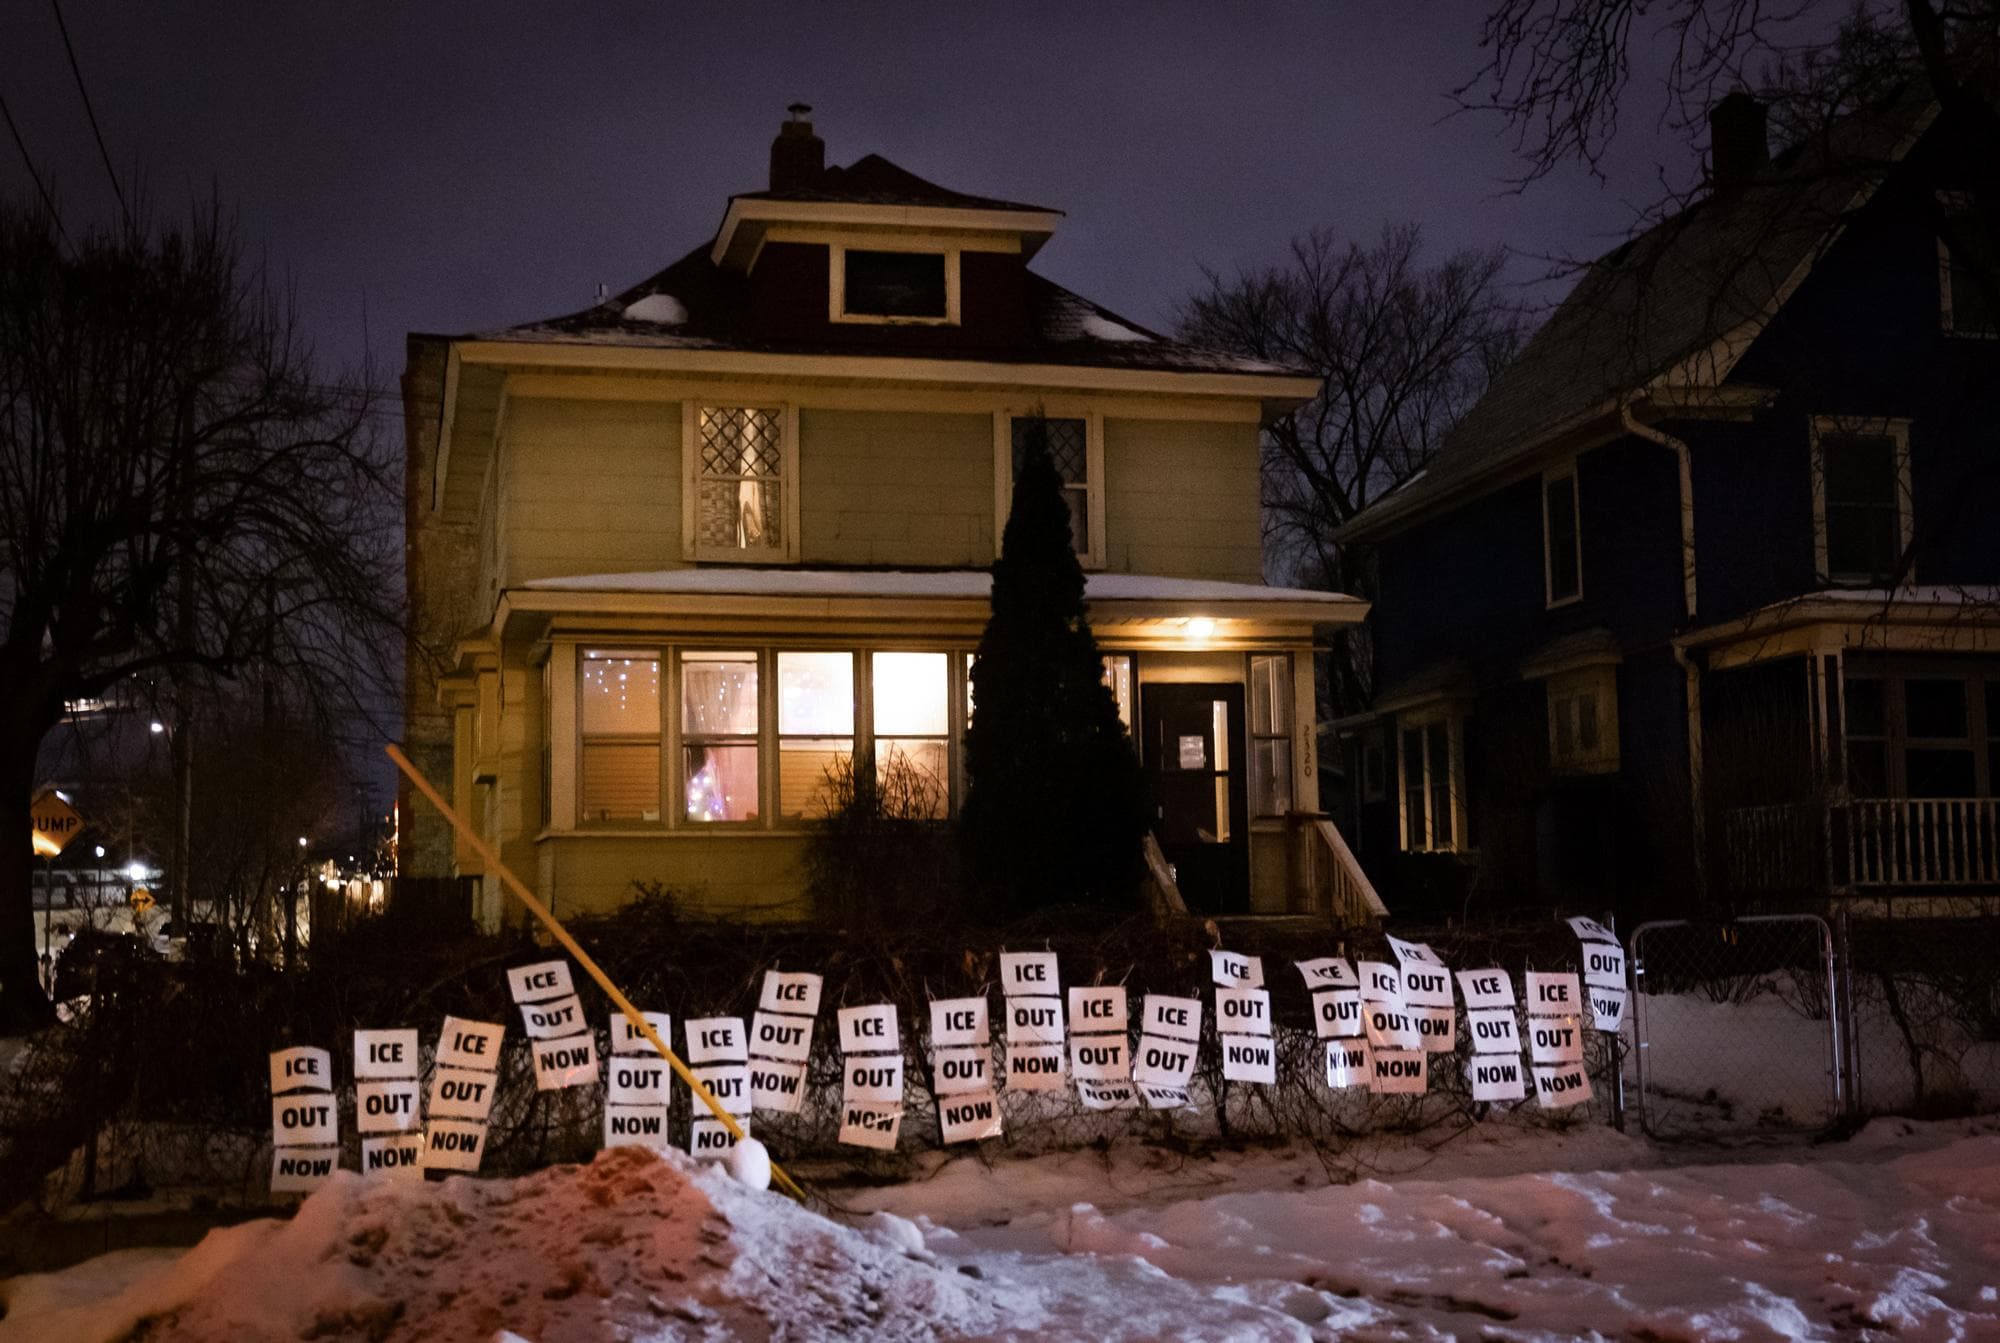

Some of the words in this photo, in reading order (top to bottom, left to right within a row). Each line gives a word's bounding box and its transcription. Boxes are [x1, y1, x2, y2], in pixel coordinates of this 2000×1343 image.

[1400, 947, 1427, 961] ICE
[1015, 964, 1046, 982] ICE
[1223, 959, 1250, 979] ICE
[1312, 966, 1342, 979] ICE
[1590, 954, 1621, 975] OUT
[525, 972, 557, 990] ICE
[1373, 973, 1396, 994] ICE
[1408, 974, 1445, 992] OUT
[1472, 977, 1501, 995] ICE
[776, 984, 808, 1001] ICE
[1539, 985, 1568, 1001] ICE
[531, 1006, 574, 1027] OUT
[1015, 1009, 1056, 1027] OUT
[1083, 999, 1113, 1018] ICE
[1158, 1007, 1188, 1026] ICE
[1224, 1000, 1263, 1018] OUT
[1323, 1002, 1359, 1021] OUT
[854, 1018, 884, 1037] ICE
[945, 1012, 975, 1030] ICE
[1373, 1013, 1409, 1031] OUT
[1477, 1021, 1510, 1038] OUT
[626, 1024, 657, 1040] IC
[702, 1030, 733, 1048] ICE
[760, 1024, 804, 1045] OUT
[1536, 1030, 1573, 1047] OUT
[370, 1043, 403, 1063] ICE
[454, 1033, 488, 1054] ICE
[540, 1048, 589, 1071] NOW
[1013, 1056, 1058, 1074] NOW
[1079, 1047, 1120, 1065] OUT
[1146, 1049, 1189, 1073] OUT
[1229, 1046, 1270, 1065] NOW
[286, 1057, 318, 1077] ICE
[943, 1059, 985, 1079] OUT
[1376, 1061, 1421, 1077] NOW
[1478, 1066, 1516, 1083] NOW
[618, 1070, 662, 1088] OUT
[751, 1071, 799, 1094] NOW
[853, 1069, 895, 1088] OUT
[1541, 1073, 1582, 1092] NOW
[441, 1081, 486, 1102] OUT
[1085, 1089, 1130, 1100] NOW
[1148, 1089, 1189, 1101] NOW
[366, 1094, 411, 1115] OUT
[947, 1102, 992, 1125] NOW
[282, 1107, 329, 1129] OUT
[612, 1117, 660, 1134] NOW
[848, 1110, 894, 1131] NOW
[431, 1132, 479, 1152] NOW
[280, 1159, 331, 1176] NOW
[369, 1147, 417, 1169] NOW
